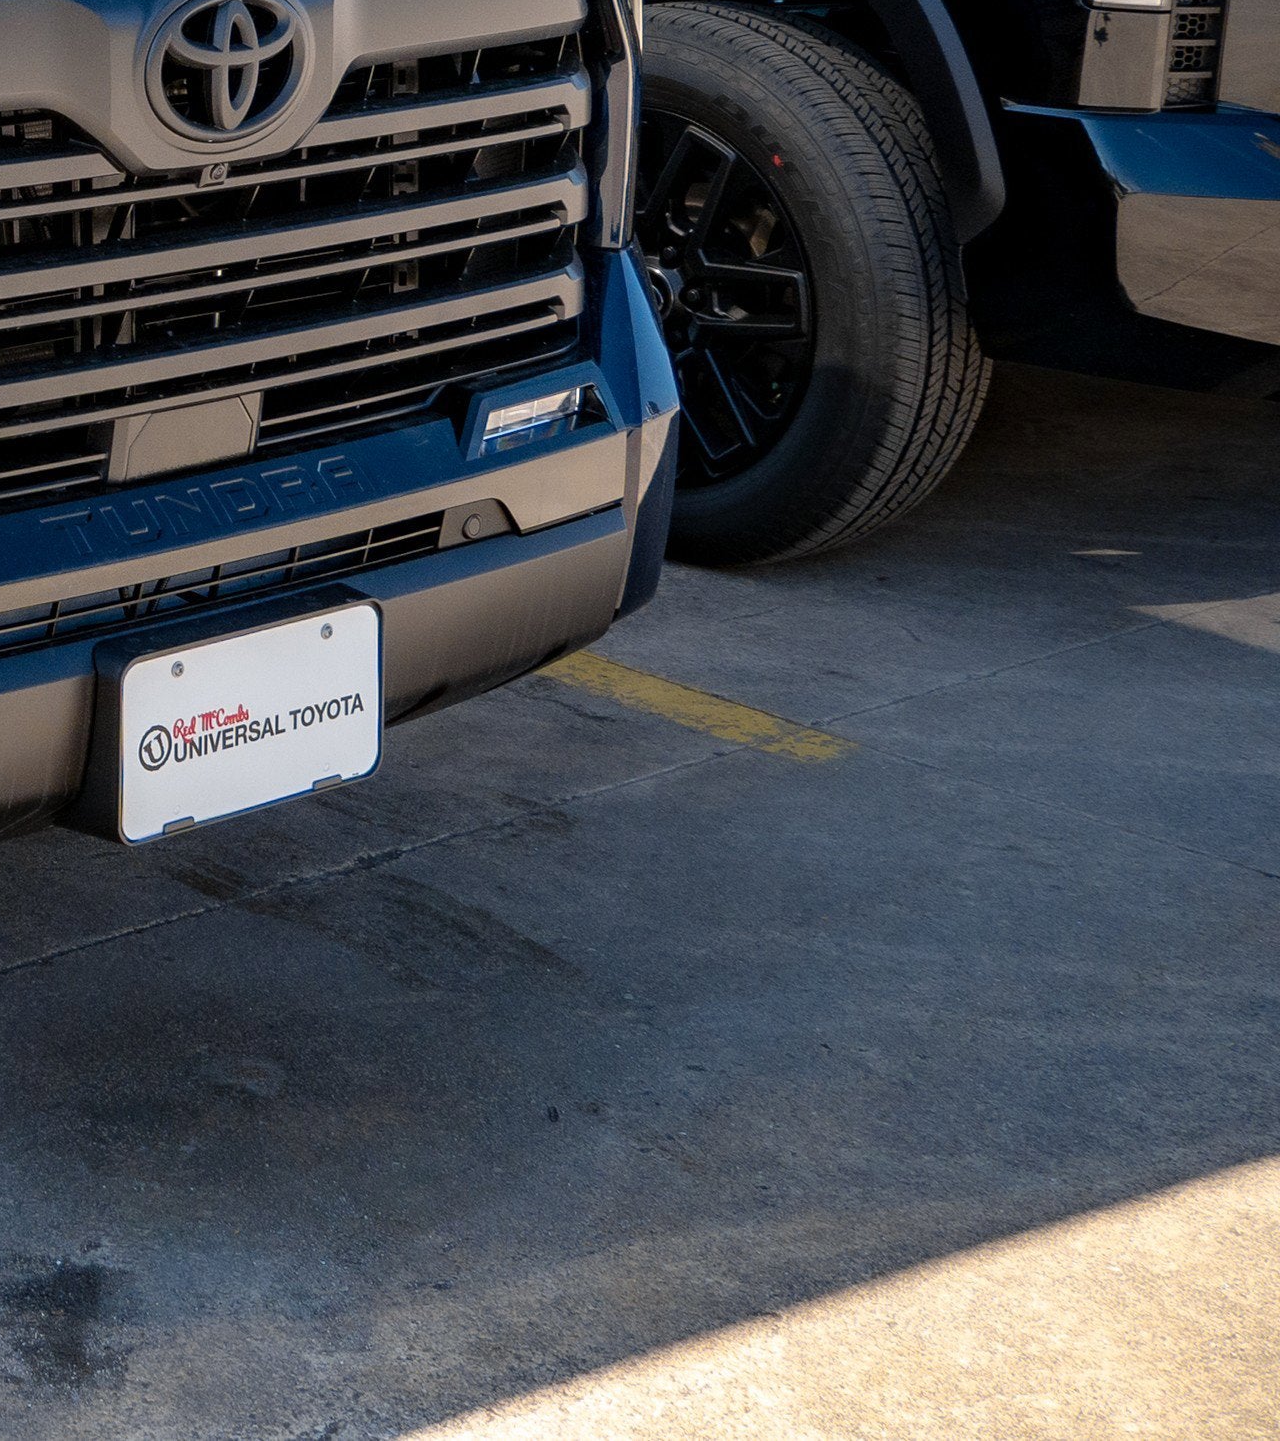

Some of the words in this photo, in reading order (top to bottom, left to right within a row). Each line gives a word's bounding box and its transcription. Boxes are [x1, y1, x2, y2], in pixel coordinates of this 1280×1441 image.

[39, 455, 376, 556] TUNDRA
[172, 716, 197, 743] Red
[174, 715, 287, 763] UNIVERSAL
[289, 693, 365, 730] TOYOTA
